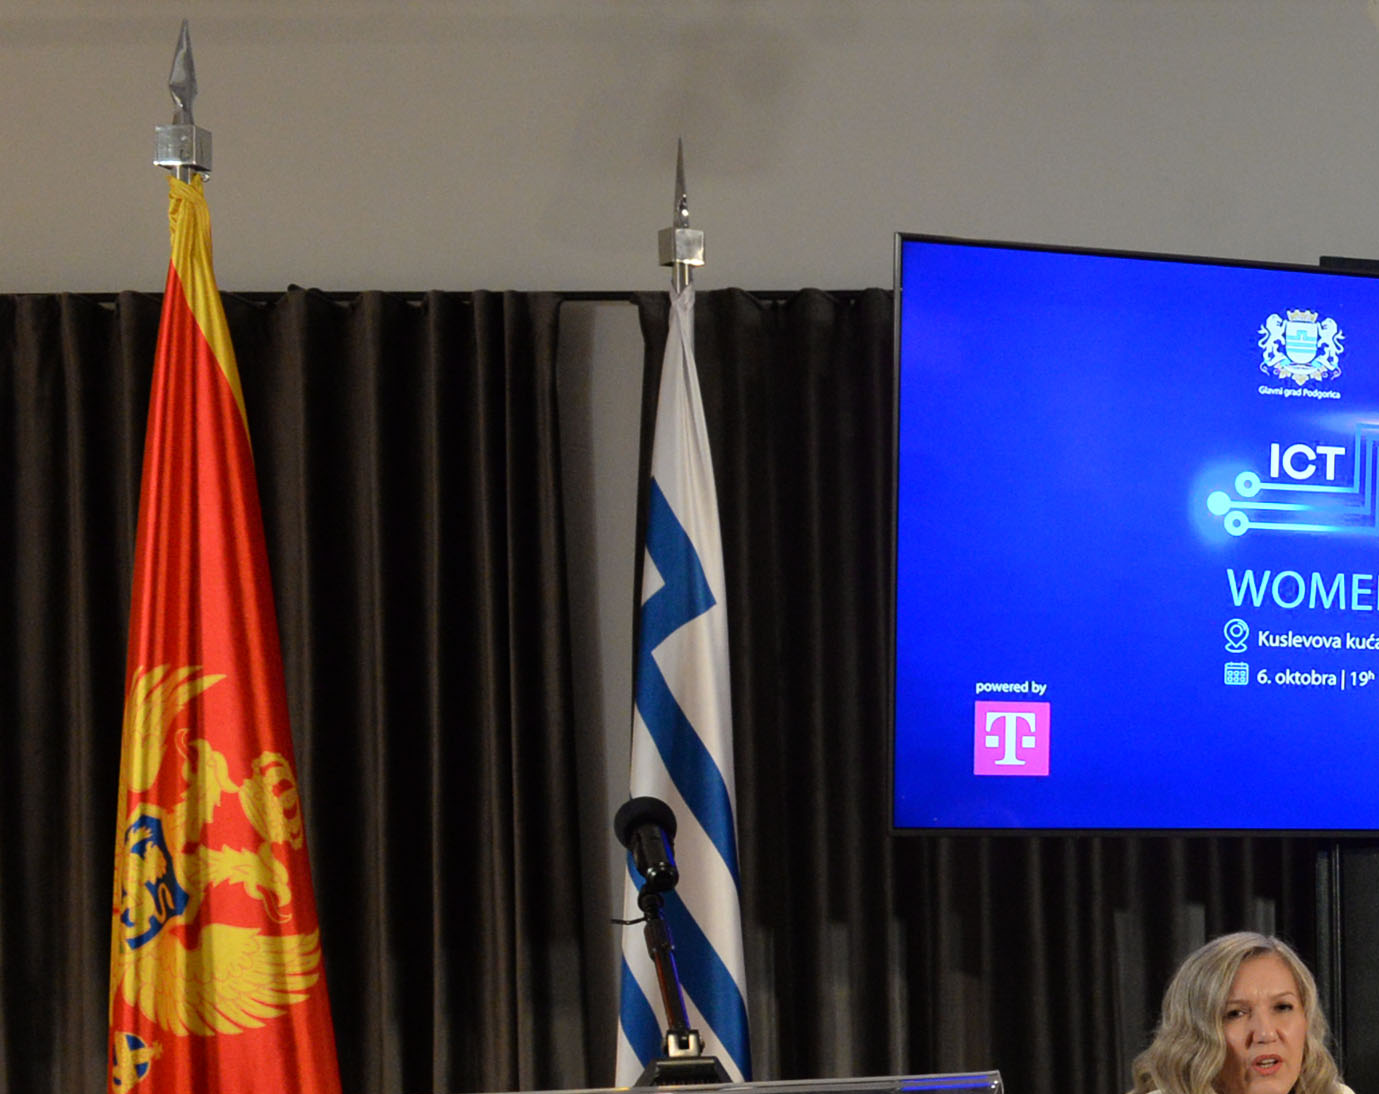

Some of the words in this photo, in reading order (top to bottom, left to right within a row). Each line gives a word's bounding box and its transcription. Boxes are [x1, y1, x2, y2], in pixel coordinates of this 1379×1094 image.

[1258, 385, 1283, 395] Glavni
[1284, 388, 1302, 398] grad
[1303, 388, 1341, 400] Podgorica
[1270, 443, 1346, 481] ICT
[1258, 630, 1342, 649] Kuslevova
[1256, 669, 1272, 685] 6.
[1275, 669, 1337, 687] oktobra
[975, 680, 1029, 695] powered
[1031, 680, 1047, 696] by
